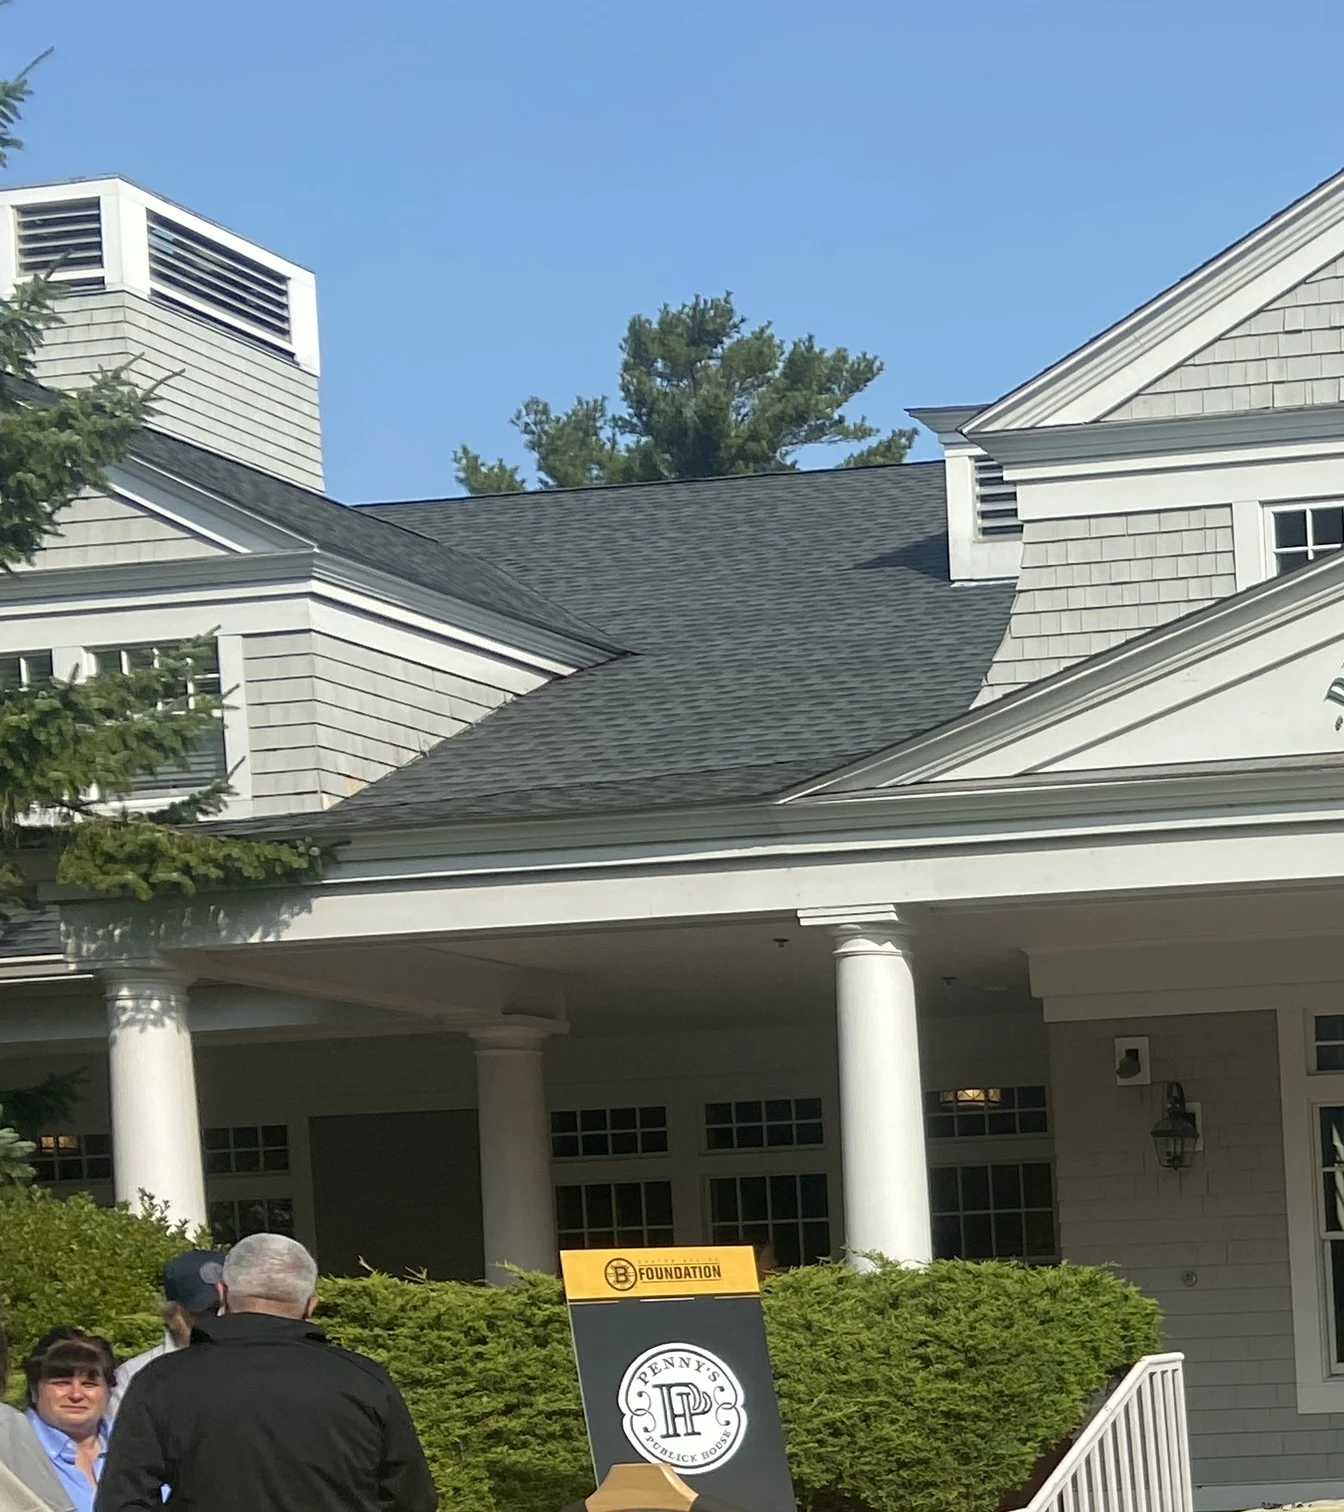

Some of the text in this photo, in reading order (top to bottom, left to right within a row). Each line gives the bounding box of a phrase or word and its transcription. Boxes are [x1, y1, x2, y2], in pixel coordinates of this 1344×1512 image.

[638, 1264, 721, 1281] FOUNDATION
[636, 1357, 721, 1386] PENNY'S
[645, 1429, 731, 1463] PUBLICK HOUSE
